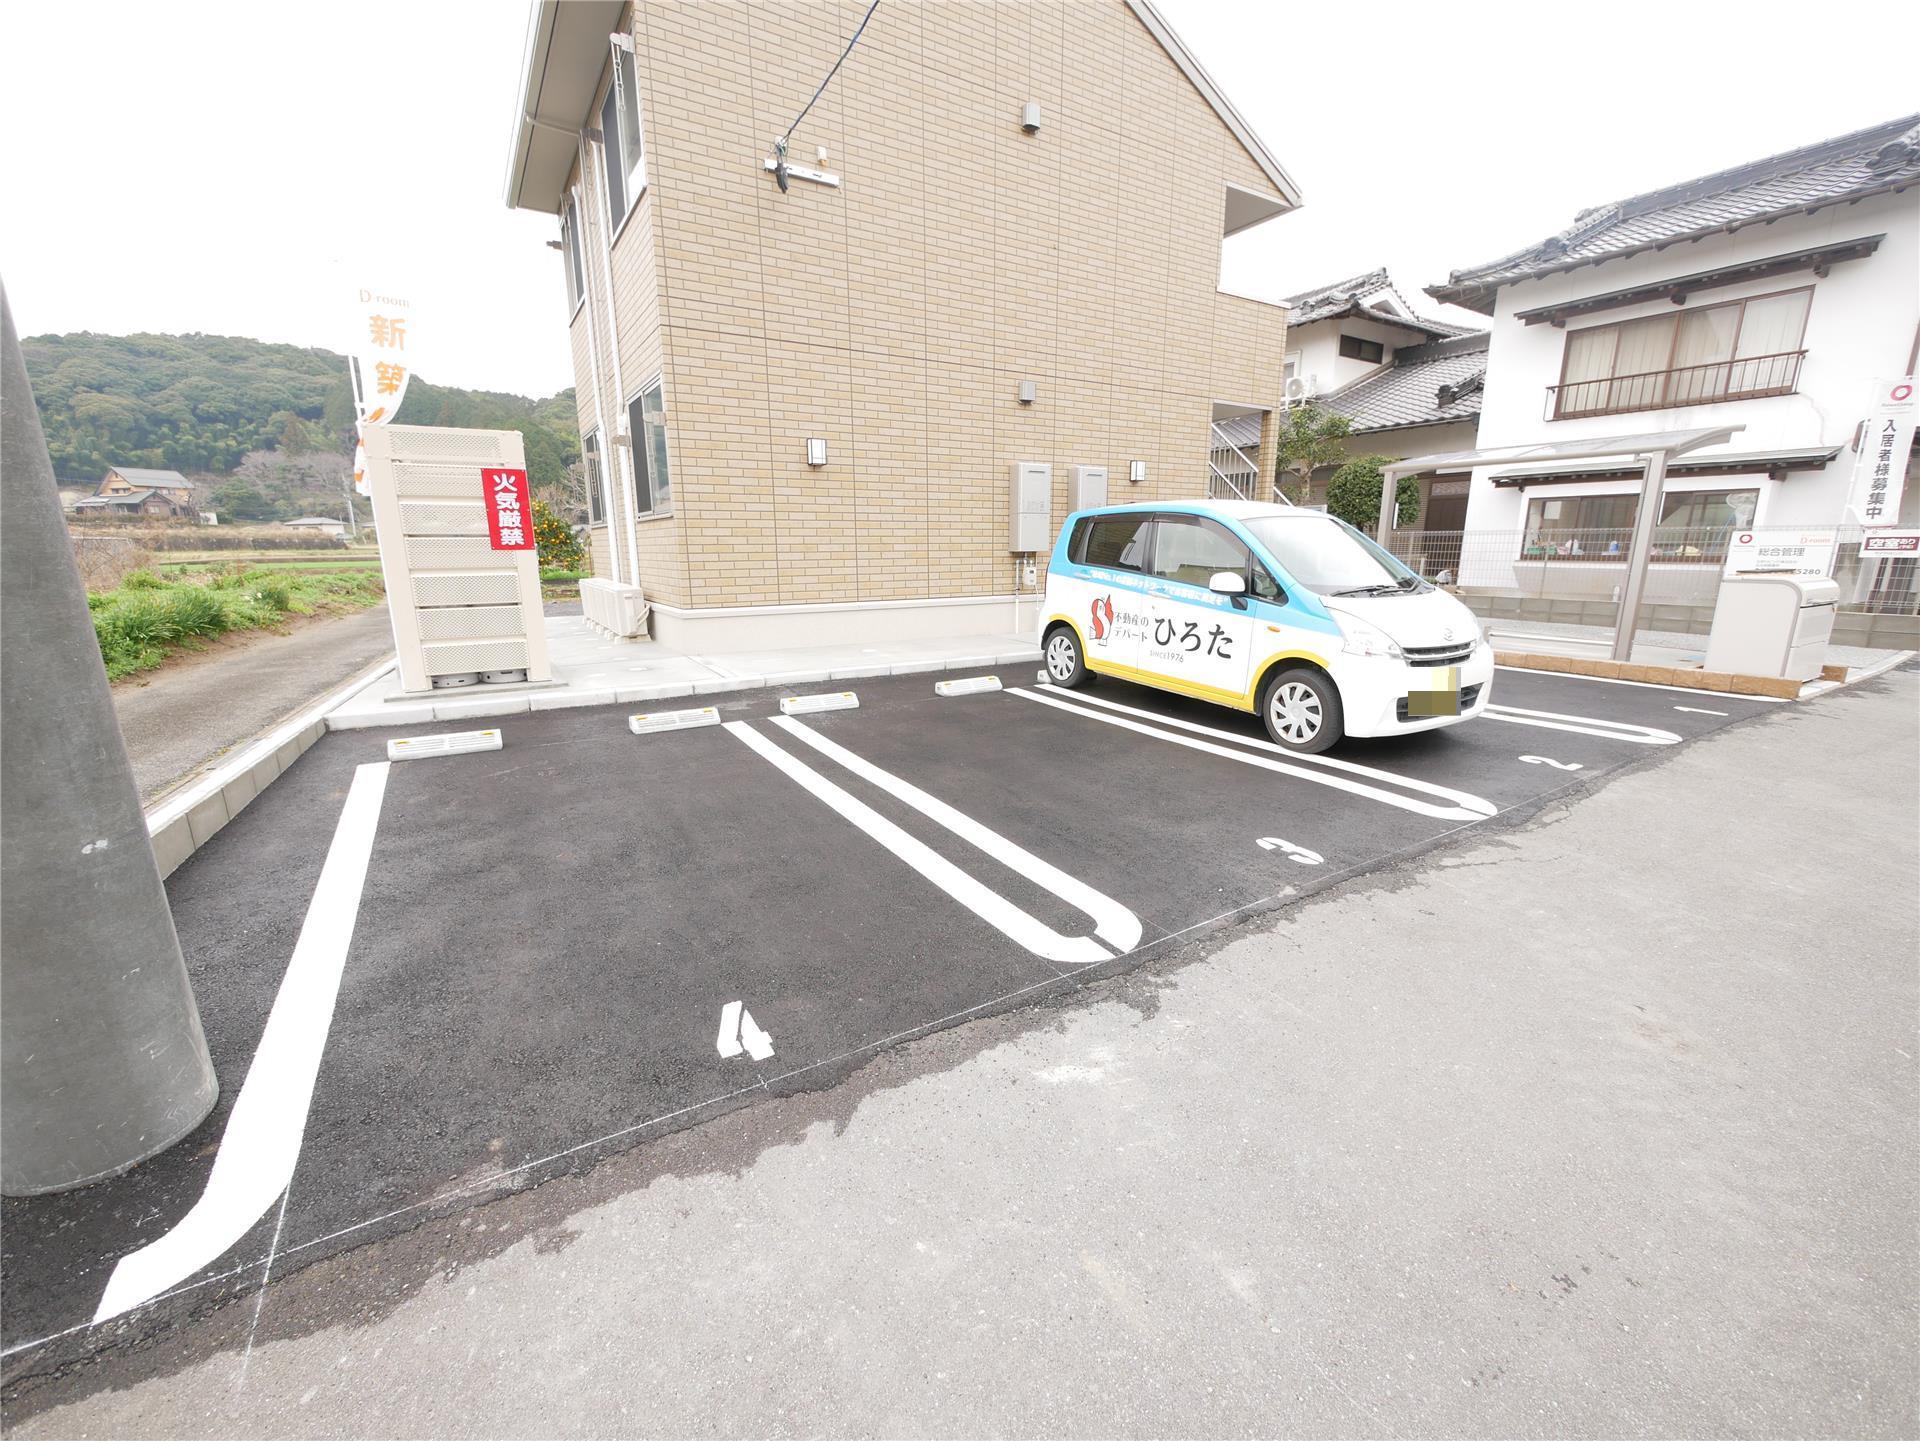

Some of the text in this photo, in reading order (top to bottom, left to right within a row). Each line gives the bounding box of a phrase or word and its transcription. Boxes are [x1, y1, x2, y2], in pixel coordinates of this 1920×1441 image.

[1865, 419, 1896, 519] 入居者様募集中
[493, 473, 525, 545] 火気厳禁
[1758, 547, 1806, 557] 総合管理
[1115, 612, 1149, 627] 不動産の
[1114, 626, 1148, 642] デパート
[1155, 617, 1233, 659] ひろた
[1518, 755, 1583, 771] 2
[1255, 837, 1325, 865] 3
[716, 1000, 775, 1061] 4
